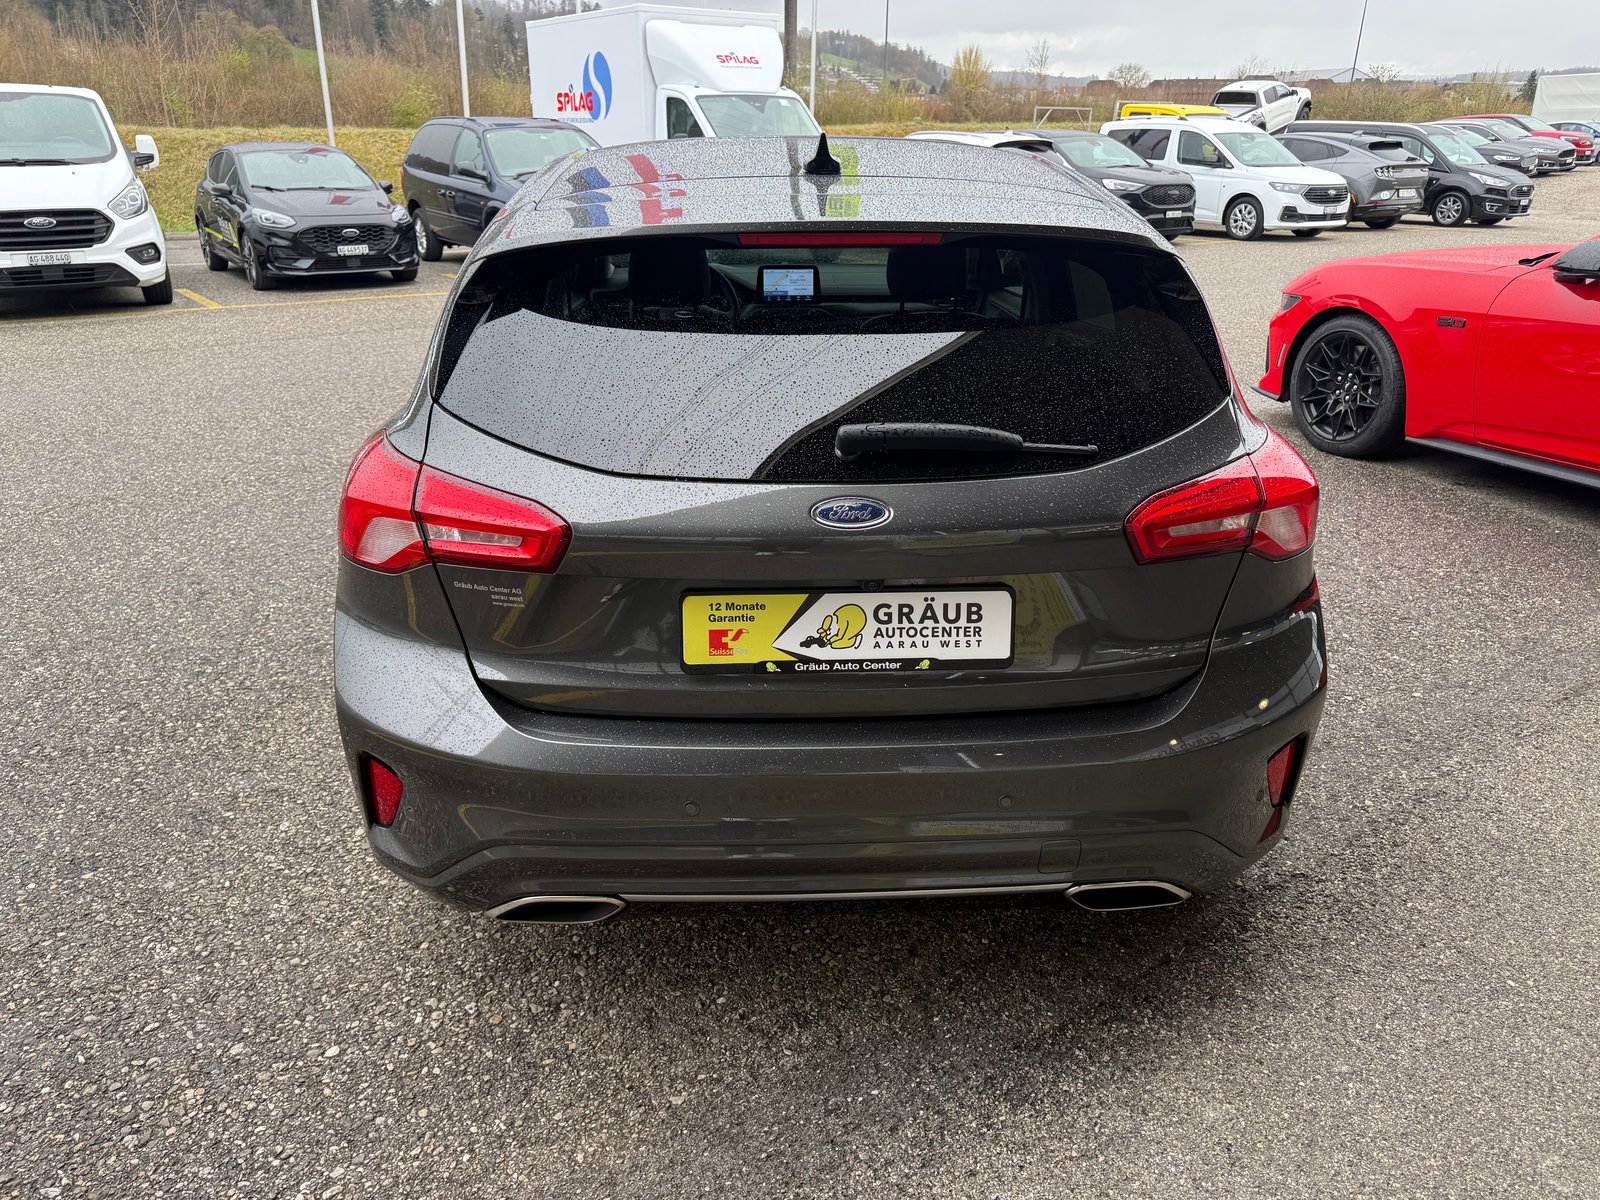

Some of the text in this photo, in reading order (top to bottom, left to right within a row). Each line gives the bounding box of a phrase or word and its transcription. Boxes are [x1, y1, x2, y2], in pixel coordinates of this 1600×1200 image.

[828, 503, 873, 521] Ford
[453, 581, 522, 595] Gräub Auto Center AG
[708, 602, 767, 612] 12 Monate
[872, 596, 984, 626] GRÄUB
[708, 613, 756, 623] Garantie
[873, 626, 983, 639] AUTOCENTER
[873, 639, 983, 650] AARAU WEST
[794, 660, 903, 672] Gräub Auto Center
